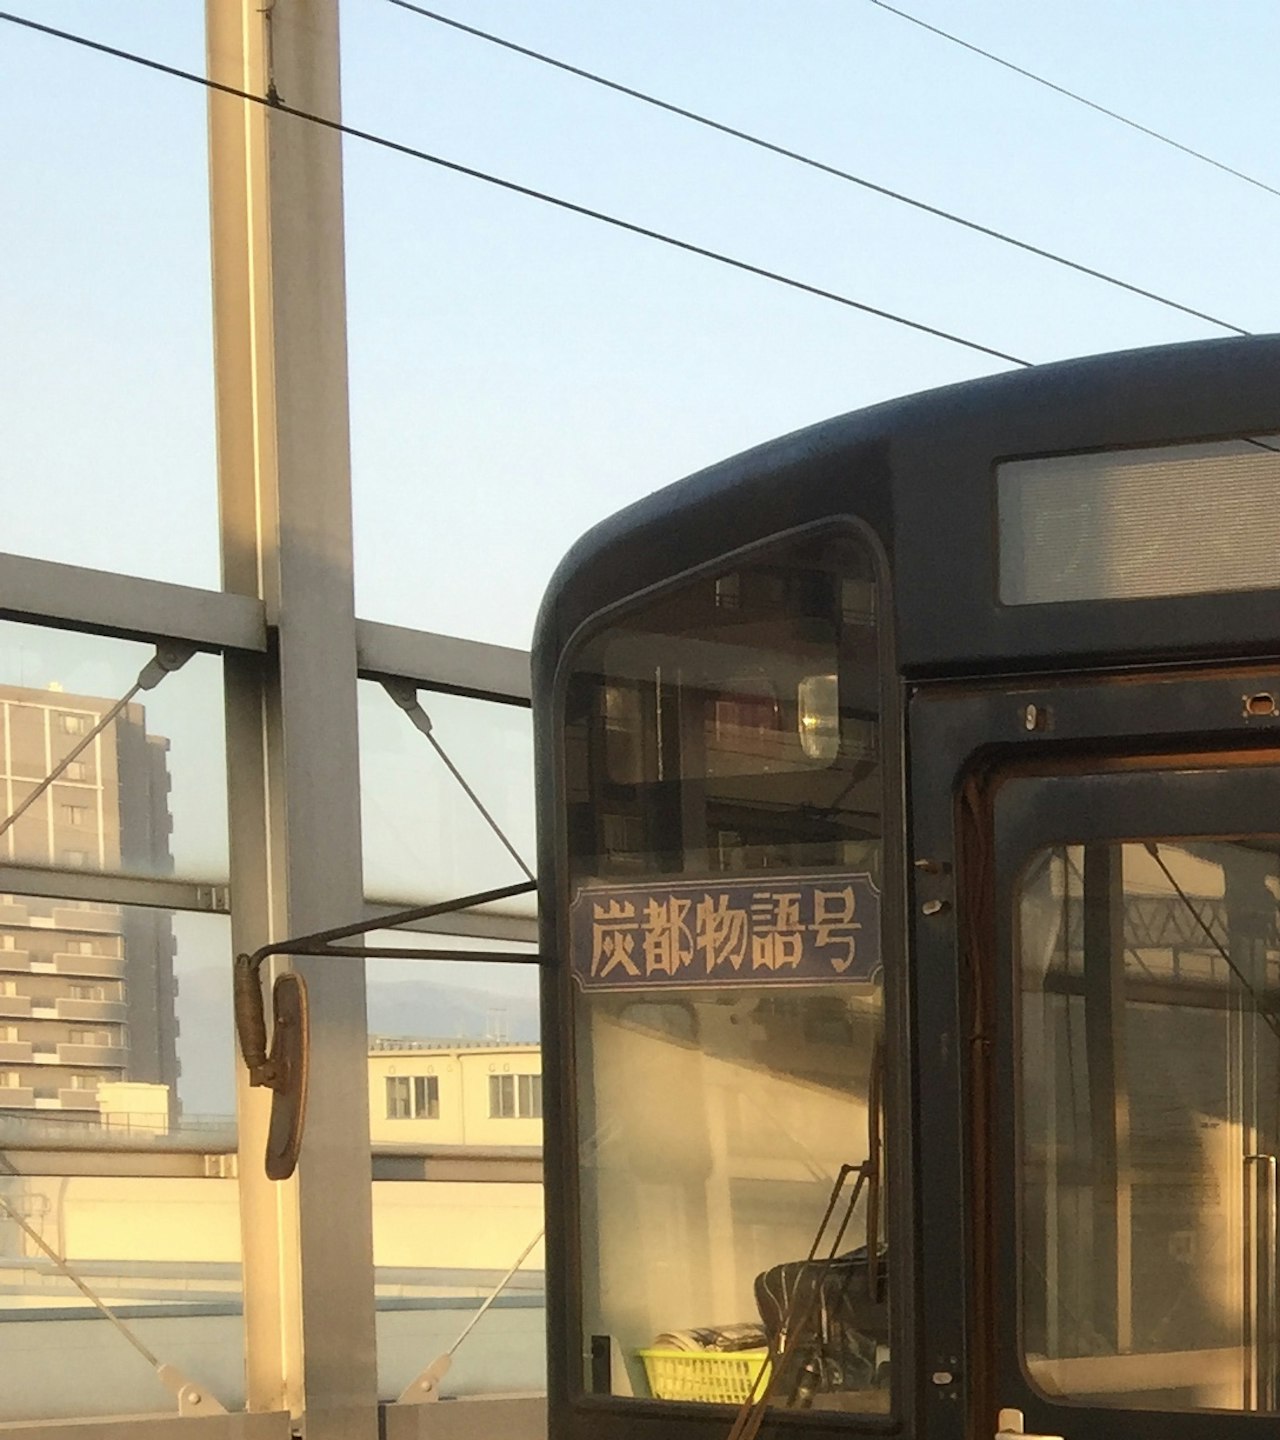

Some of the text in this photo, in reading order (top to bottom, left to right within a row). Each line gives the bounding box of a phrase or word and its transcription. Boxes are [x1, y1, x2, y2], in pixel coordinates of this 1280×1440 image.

[590, 885, 862, 977] 炭都物語号
